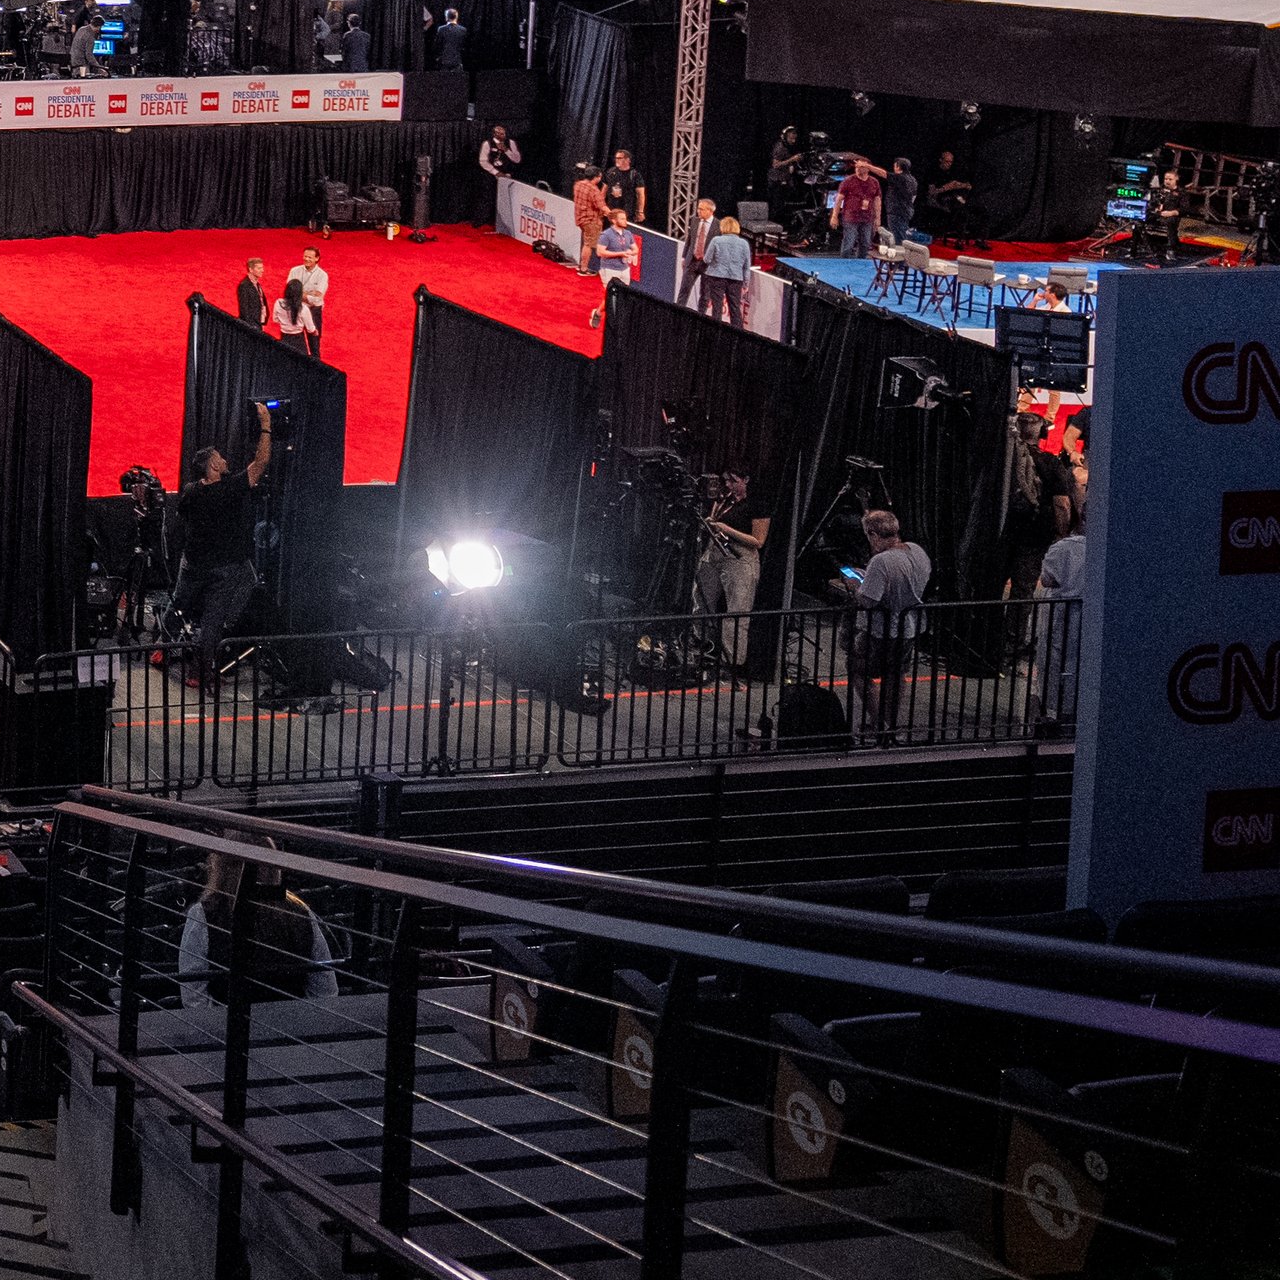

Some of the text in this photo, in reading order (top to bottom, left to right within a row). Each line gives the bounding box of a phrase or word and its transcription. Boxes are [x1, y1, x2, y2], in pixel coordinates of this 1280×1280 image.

[155, 84, 174, 93] CNN
[338, 80, 357, 90] CNN
[140, 92, 188, 102] PRESIDENTIAL
[323, 87, 369, 98] PRESIDENTIAL
[16, 101, 33, 111] CNN
[140, 97, 218, 116] DEBATE CNN
[323, 94, 399, 112] DEBATE CNN
[519, 216, 557, 243] DEBATE
[1211, 813, 1274, 846] CNN
